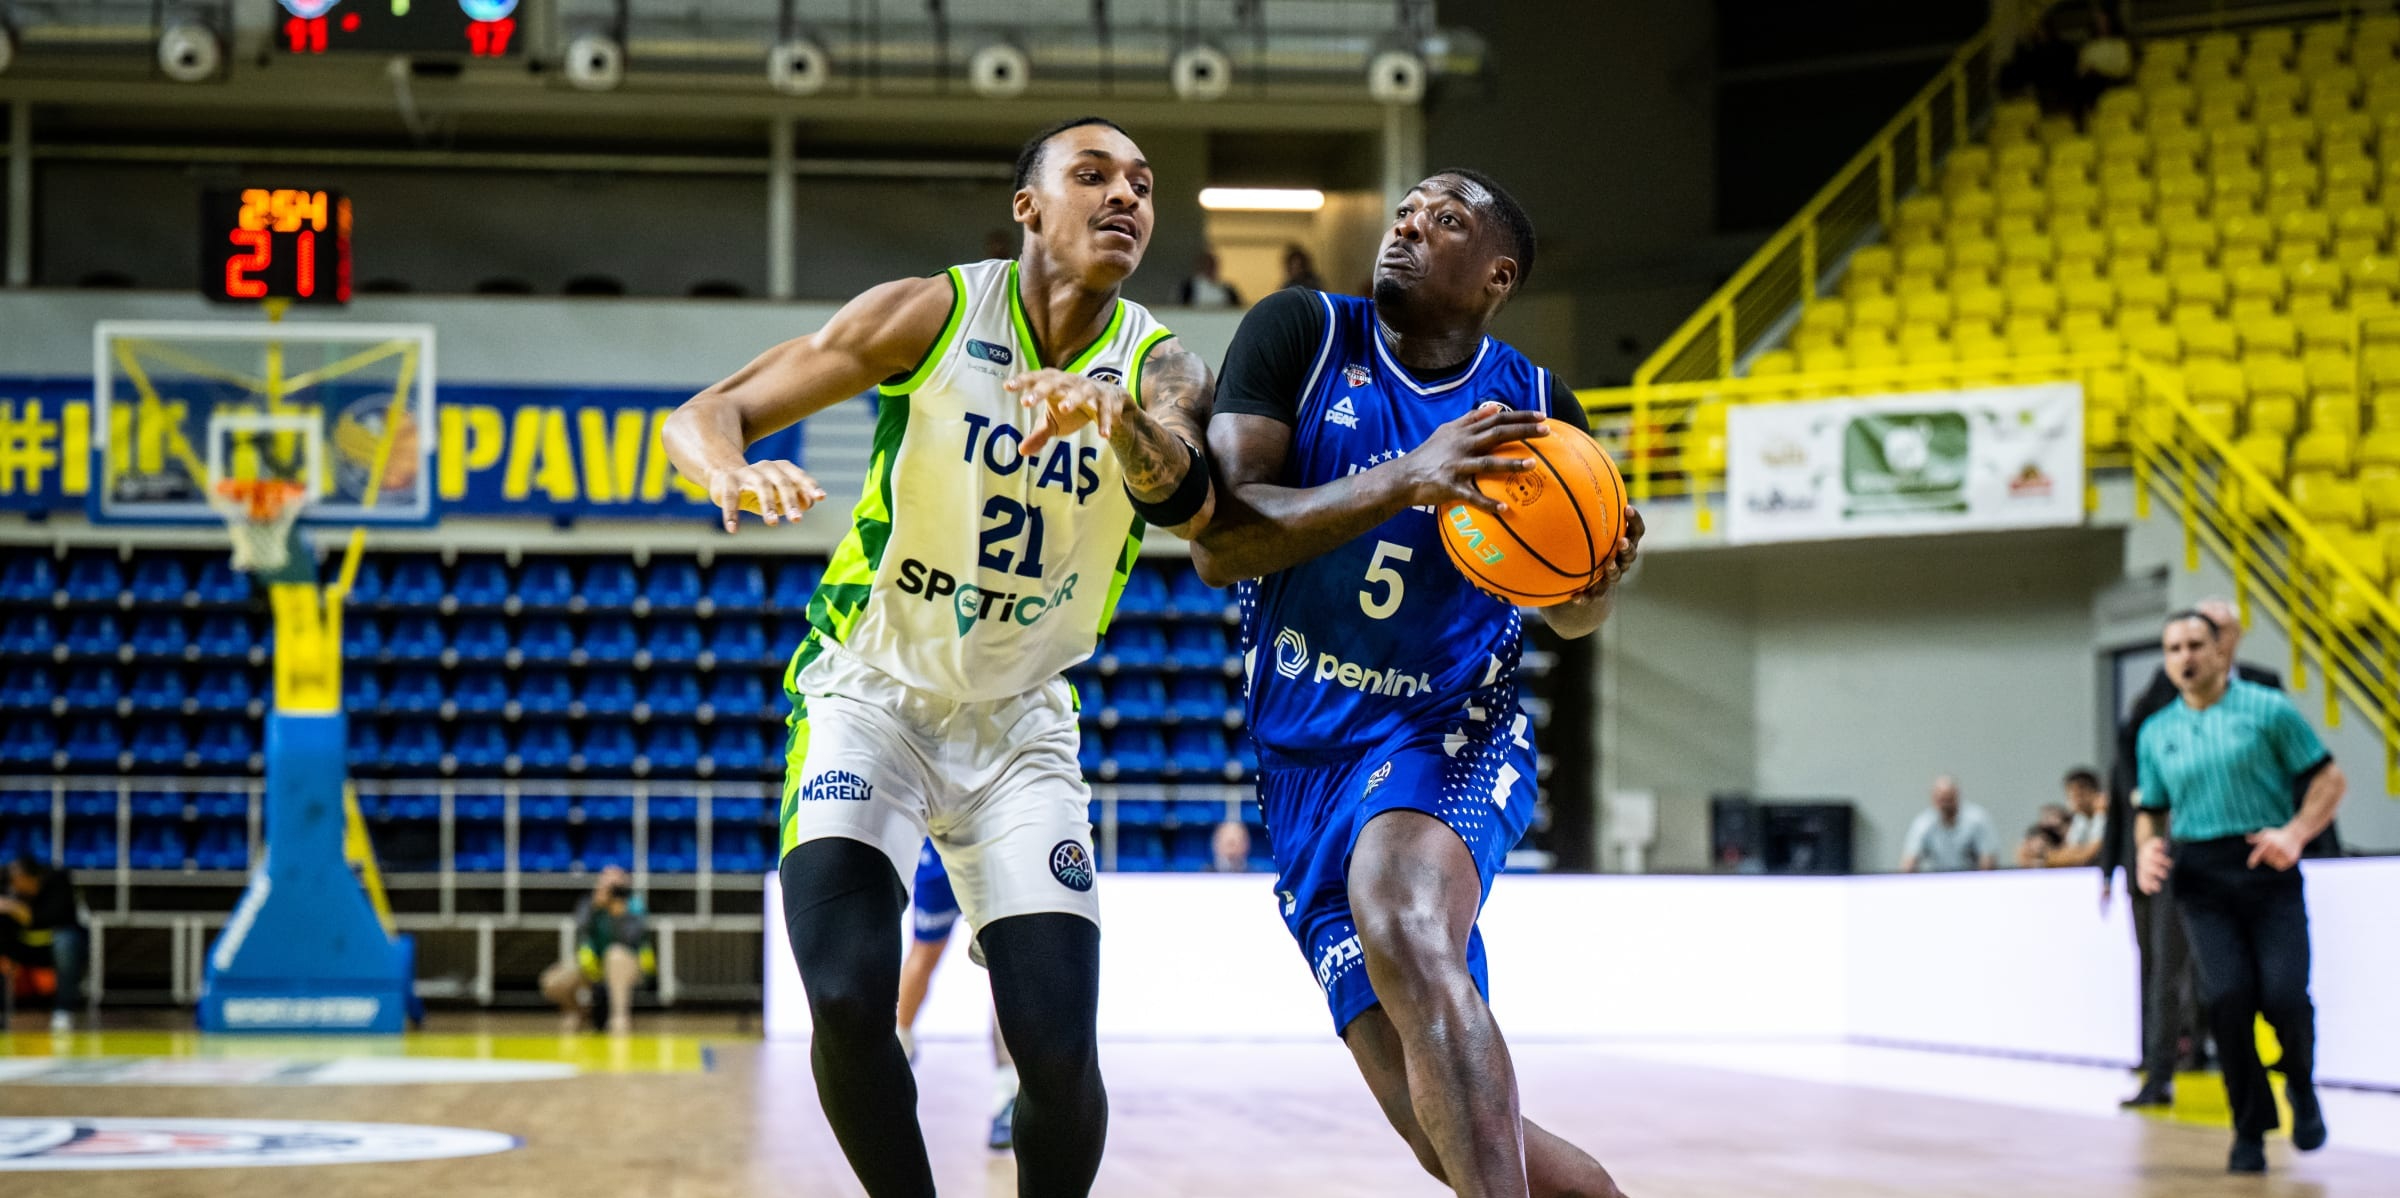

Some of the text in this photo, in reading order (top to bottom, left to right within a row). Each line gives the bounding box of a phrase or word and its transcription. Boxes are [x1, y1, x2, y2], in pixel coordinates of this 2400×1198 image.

[226, 228, 315, 298] 21
[1324, 409, 1360, 430] PEAK
[963, 411, 1100, 505] TOAŞ
[978, 494, 1044, 578] 21
[1359, 539, 1413, 620] 5
[1313, 652, 1433, 698] penlink
